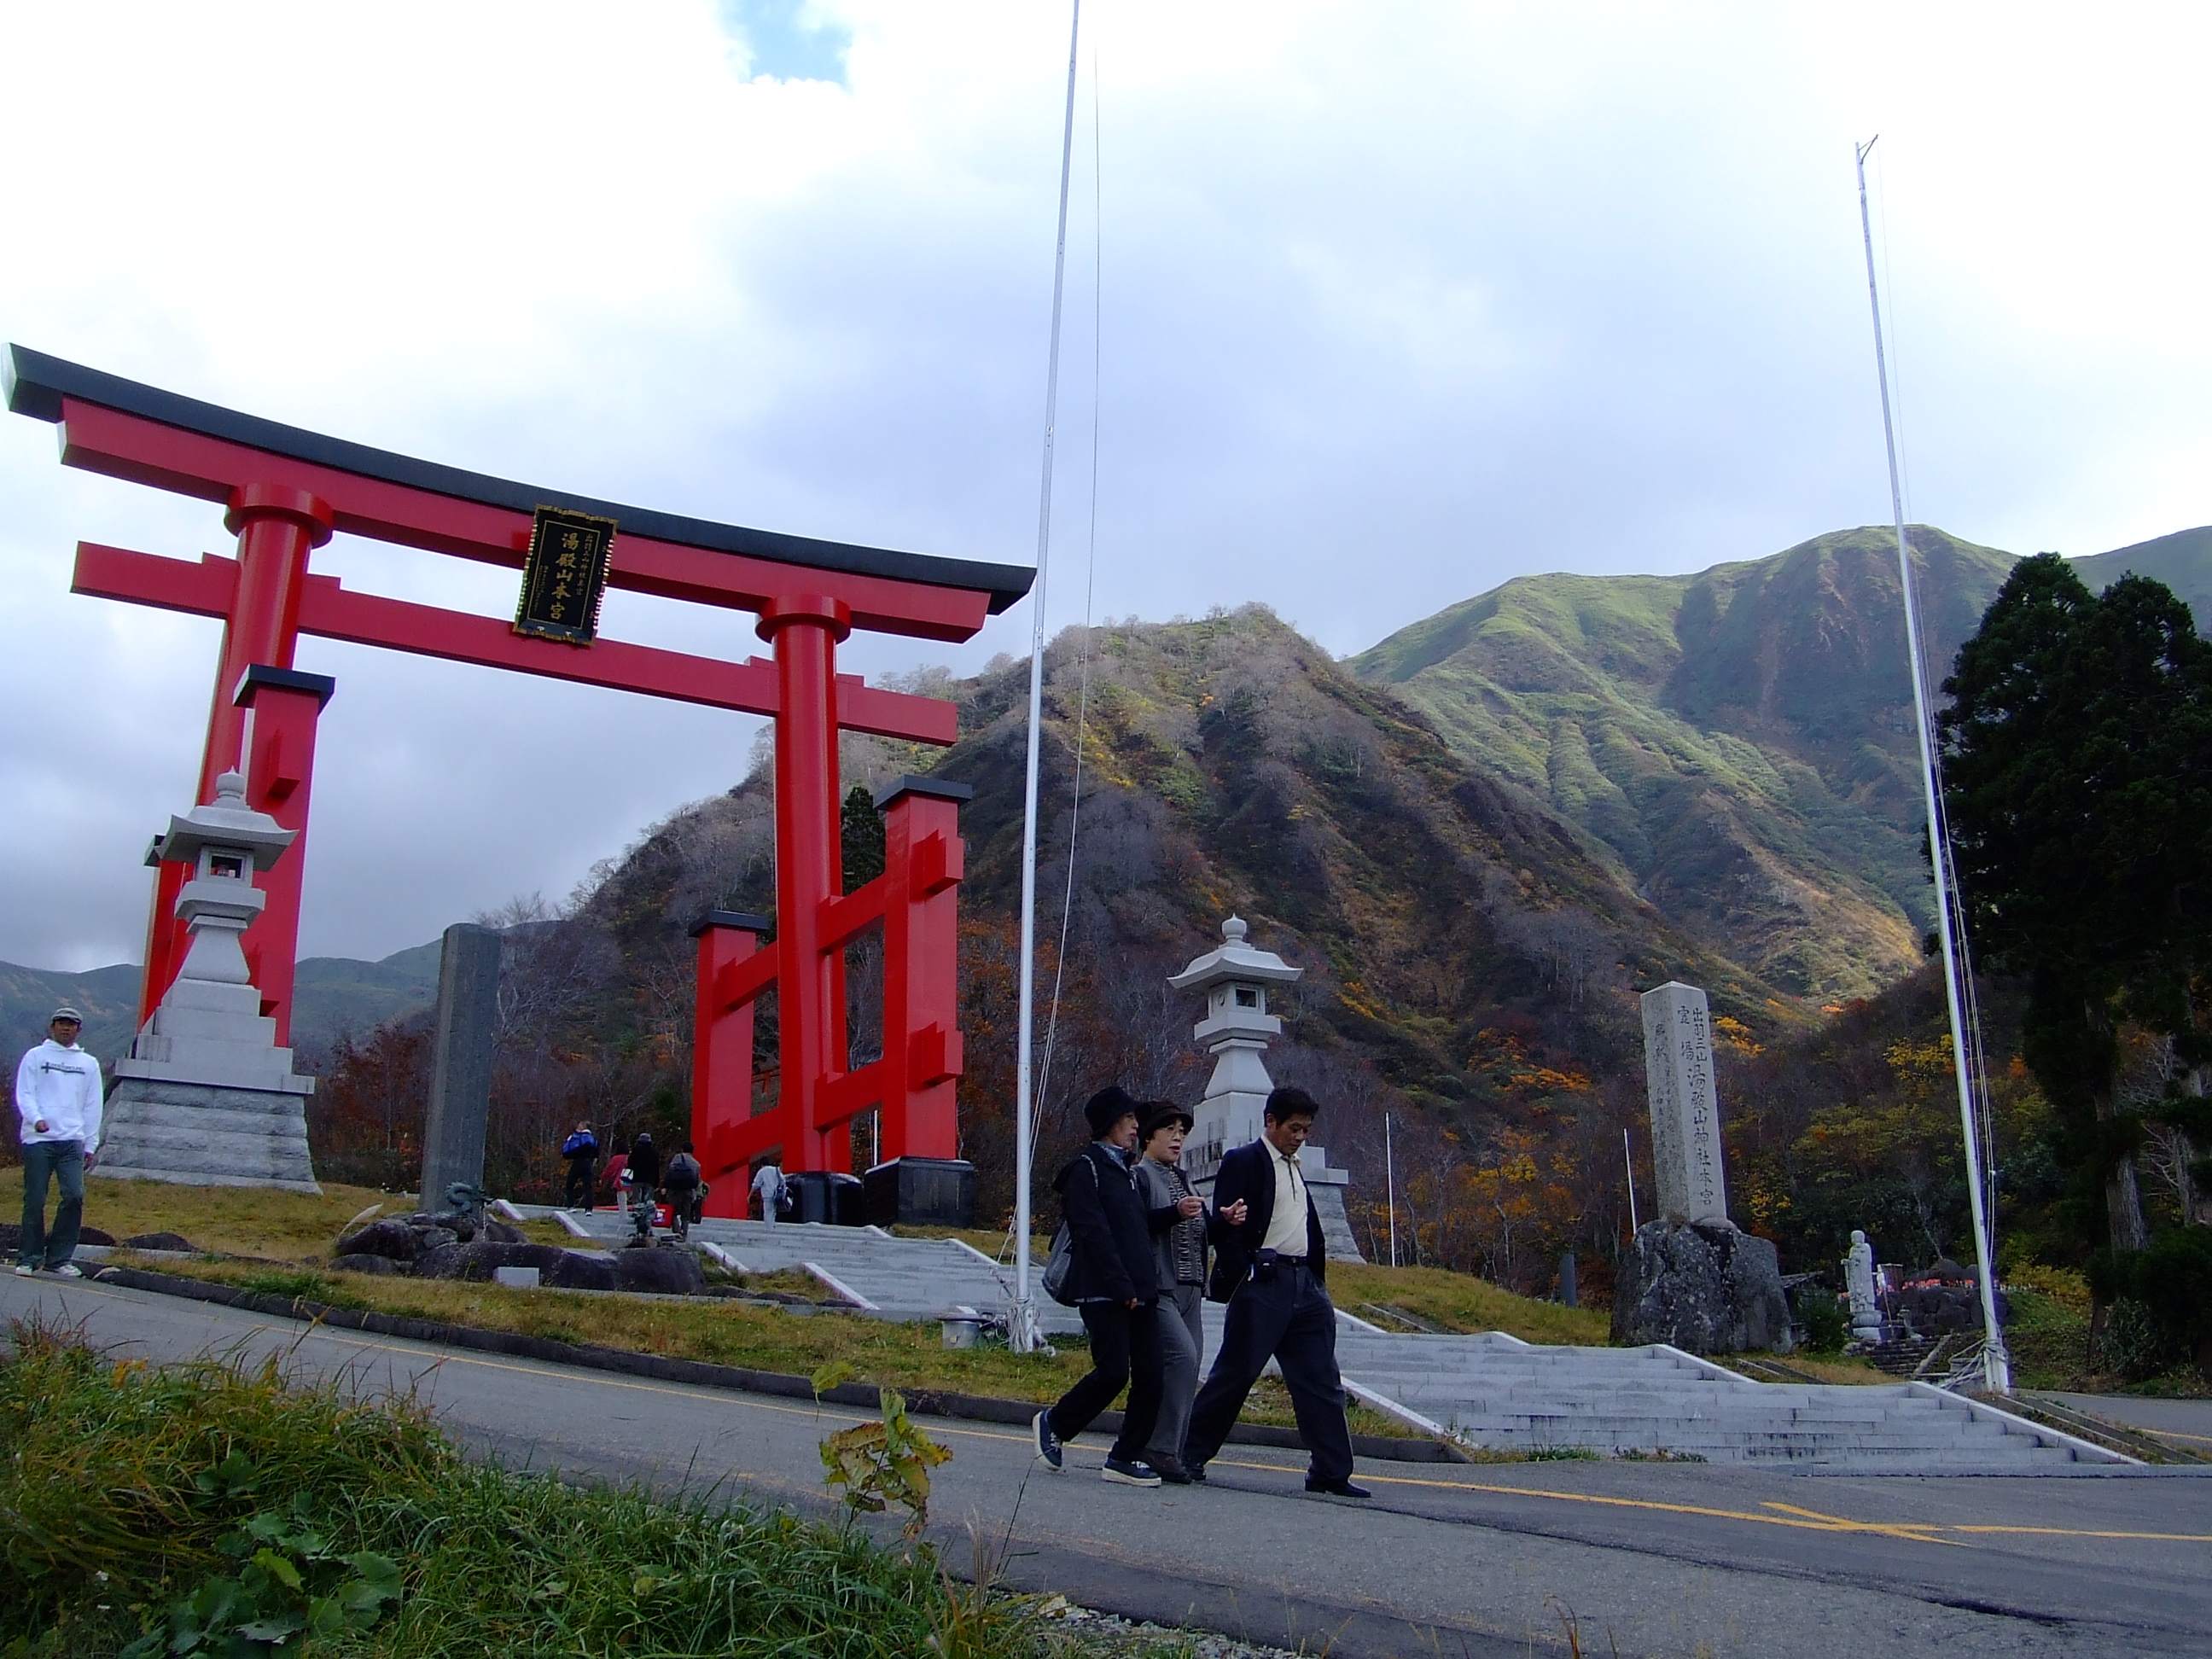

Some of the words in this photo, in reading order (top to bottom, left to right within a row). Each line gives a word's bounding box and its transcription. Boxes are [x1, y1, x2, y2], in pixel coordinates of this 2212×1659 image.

[550, 533, 579, 620] 湯殿山本宮
[1692, 1007, 1708, 1062] 出羽三山
[1686, 1063, 1714, 1206] 湯殿山神社本宮
